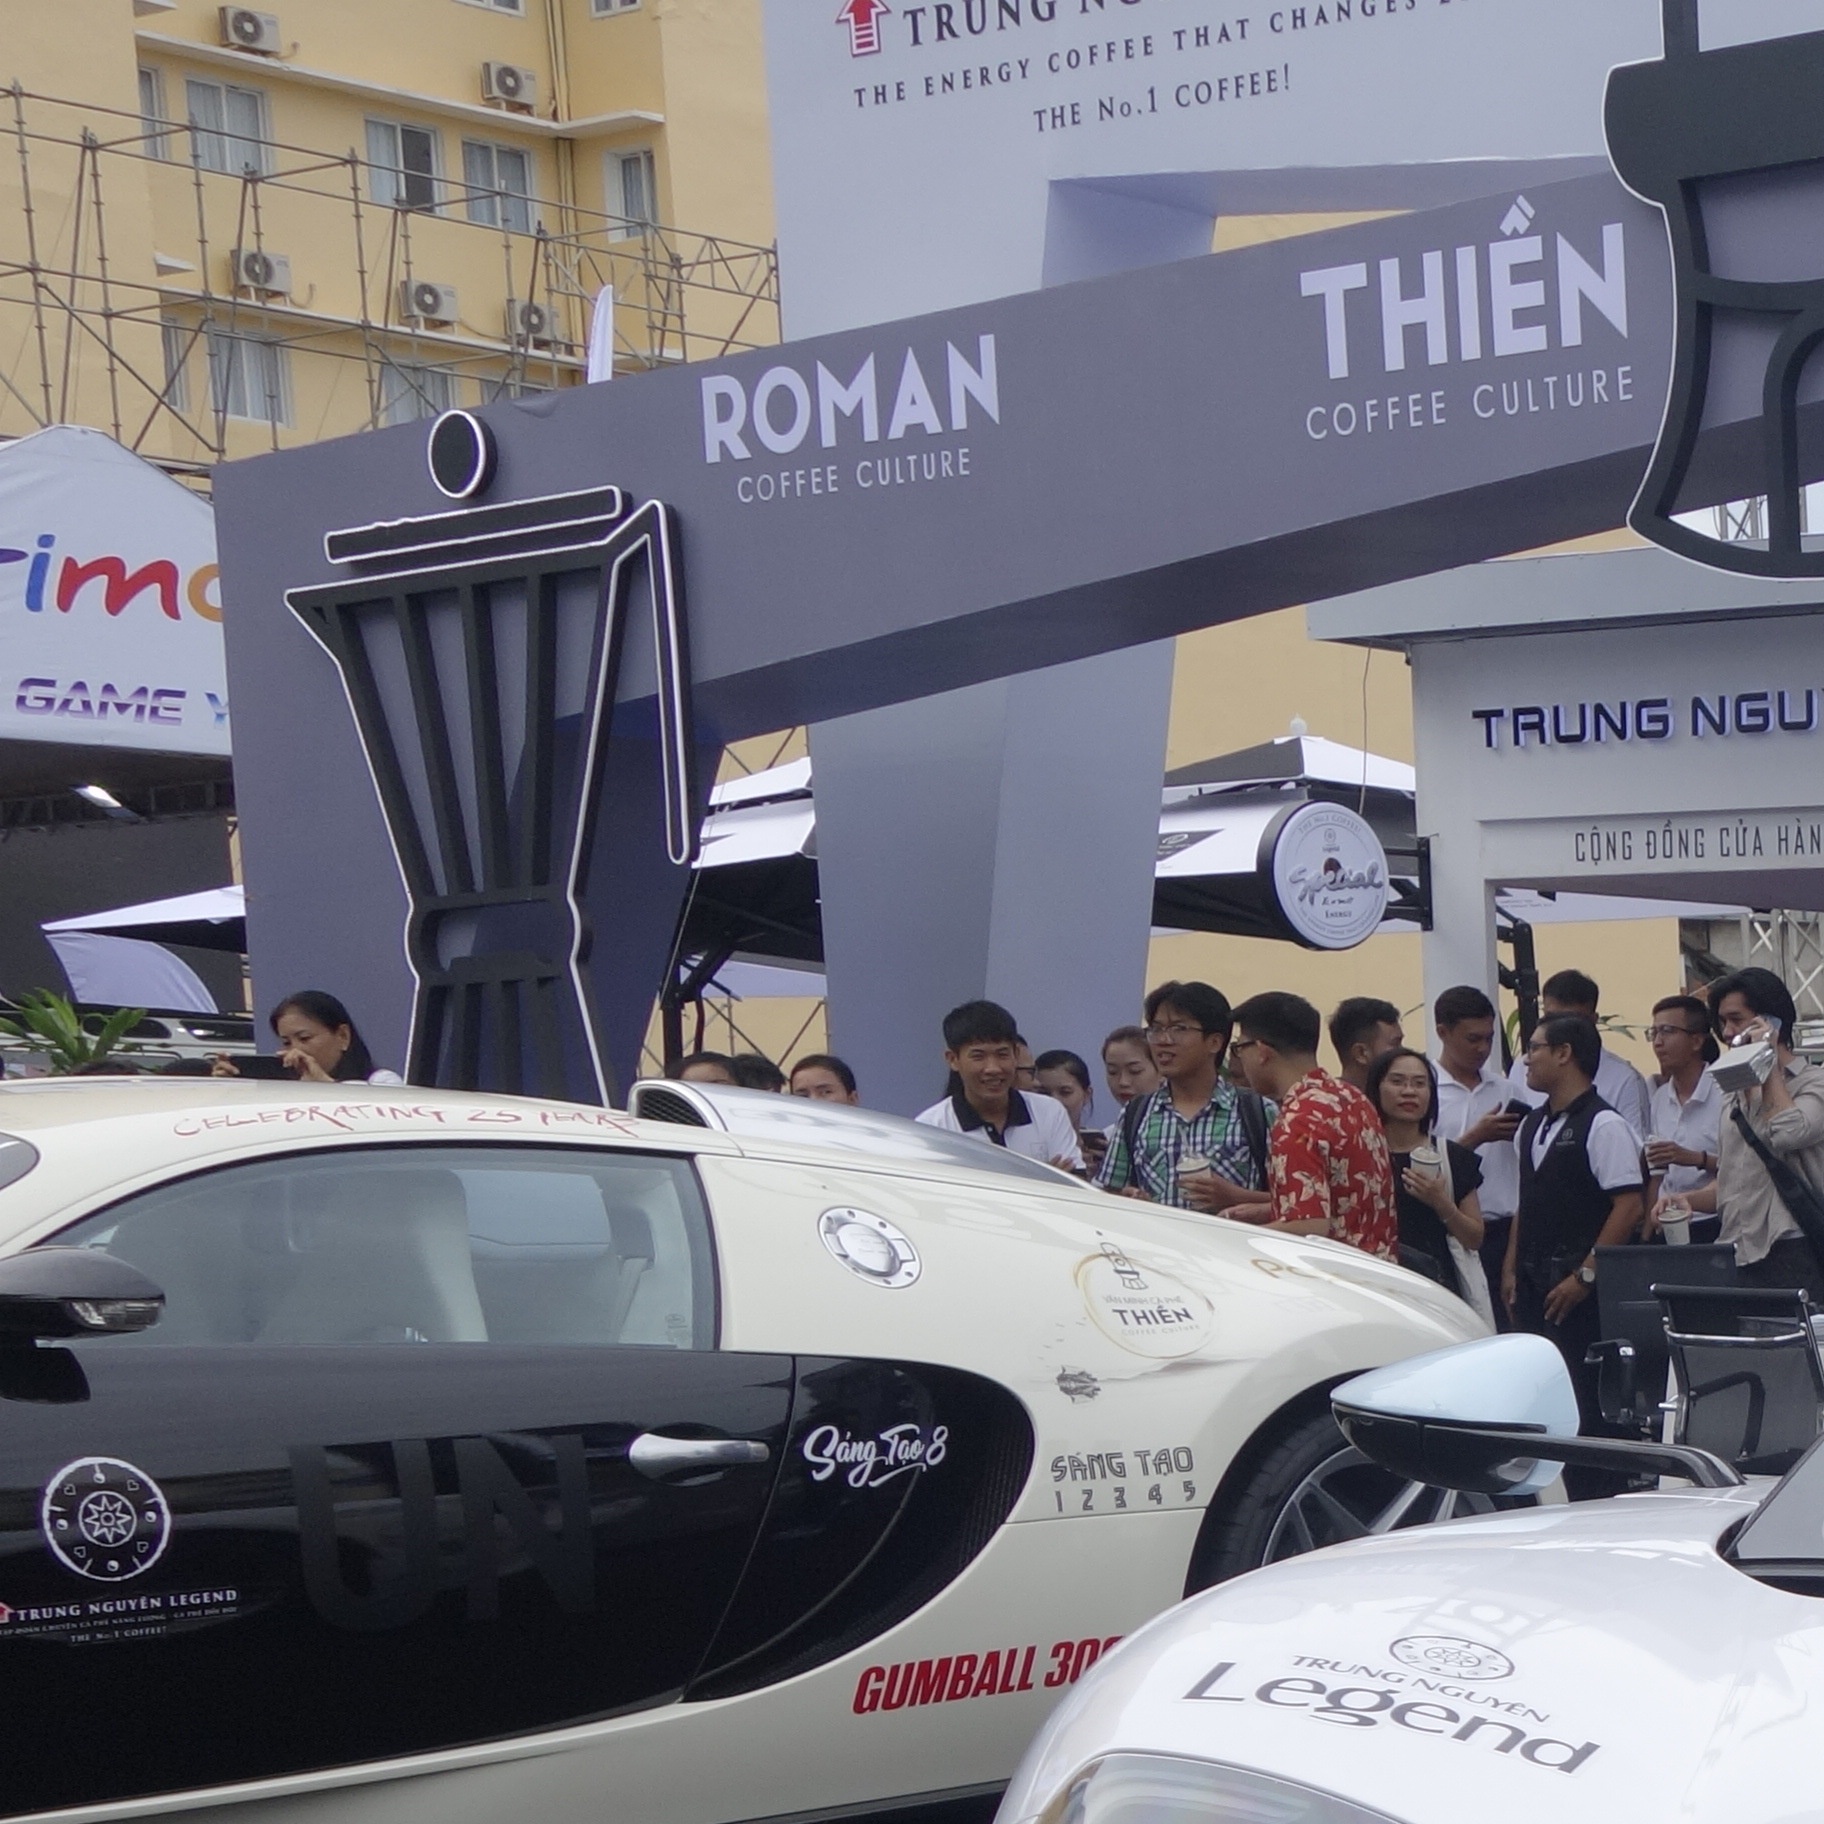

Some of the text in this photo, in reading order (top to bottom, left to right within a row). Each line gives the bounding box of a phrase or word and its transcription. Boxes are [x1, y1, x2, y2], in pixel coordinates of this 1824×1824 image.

[854, 86, 906, 109] THE
[924, 58, 1030, 99] ENERGY
[1047, 35, 1155, 74] COFFEE
[1173, 17, 1250, 52] THAT
[1033, 62, 1292, 134] THE No.1 COFFEE!
[702, 334, 1000, 464] ROMAN
[1305, 366, 1635, 440] COFFEE CULTURE
[737, 447, 972, 504] COFFEE CULTURE
[15, 677, 187, 727] GAME
[1472, 697, 1674, 749] TRUNG
[1574, 822, 1633, 866] CỘNG
[1645, 818, 1706, 860] ĐỒNG
[1719, 815, 1764, 858] CỬA
[173, 1103, 446, 1137] CELEBRATING
[466, 1108, 523, 1124] 25
[803, 1425, 877, 1488] Sáng
[925, 1425, 949, 1466] 8
[1050, 1446, 1194, 1483] SÁNG TẠO
[1055, 1479, 1197, 1514] 1 2 3 4 5
[18, 1589, 238, 1622] TRUNG NGUYÊN LEGEND
[70, 1633, 91, 1644] THE
[852, 1645, 1037, 1715] GUMBALL
[1292, 1653, 1552, 1724] TRUNG NGUYÊN
[1182, 1660, 1602, 1775] Legend
